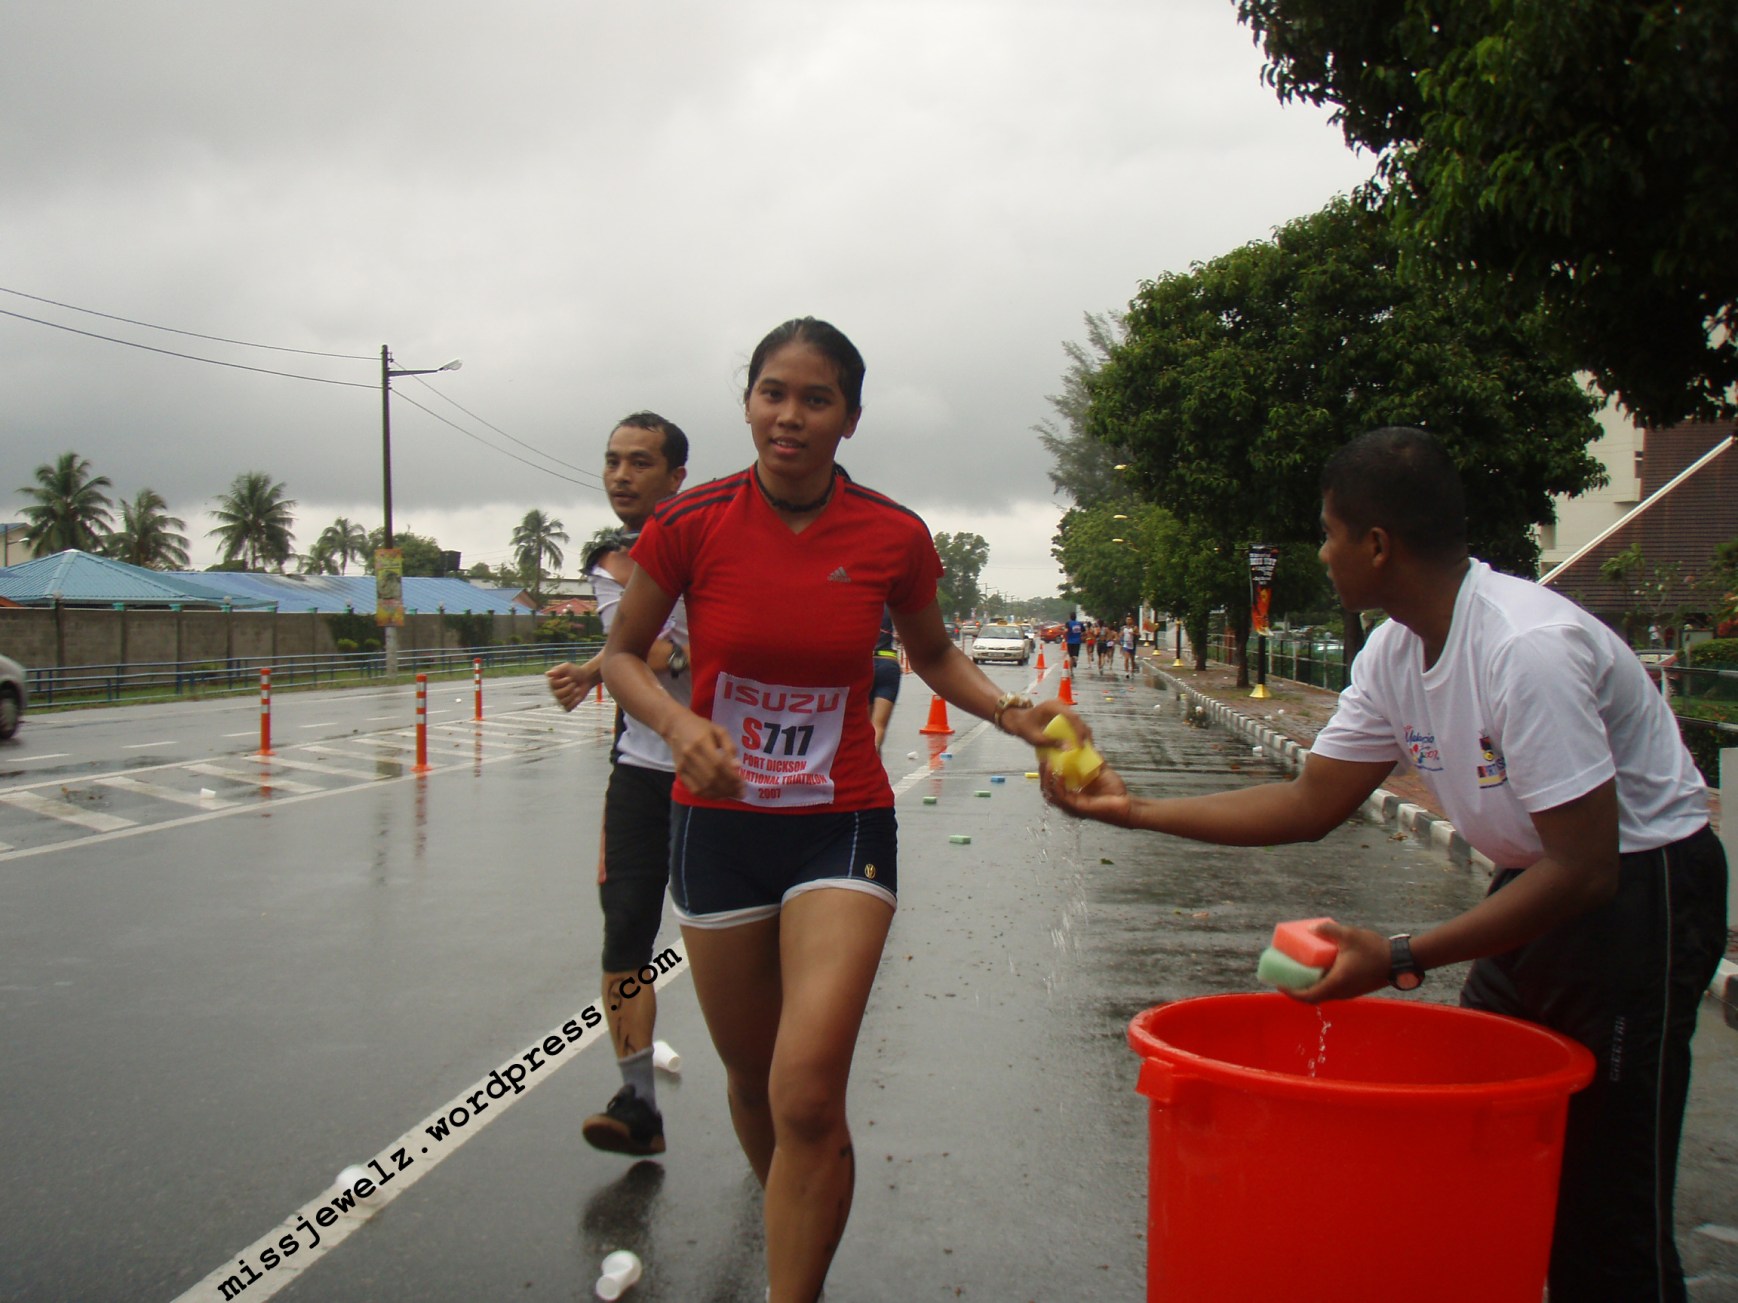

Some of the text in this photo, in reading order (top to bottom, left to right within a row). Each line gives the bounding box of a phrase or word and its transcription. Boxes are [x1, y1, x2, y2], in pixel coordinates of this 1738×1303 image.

[724, 681, 839, 713] ISUZU
[741, 717, 815, 755] S717
[743, 753, 807, 773] PORT DICKSON
[735, 767, 827, 785] NATIONAL TRIATHLON
[758, 788, 782, 799] 2007
